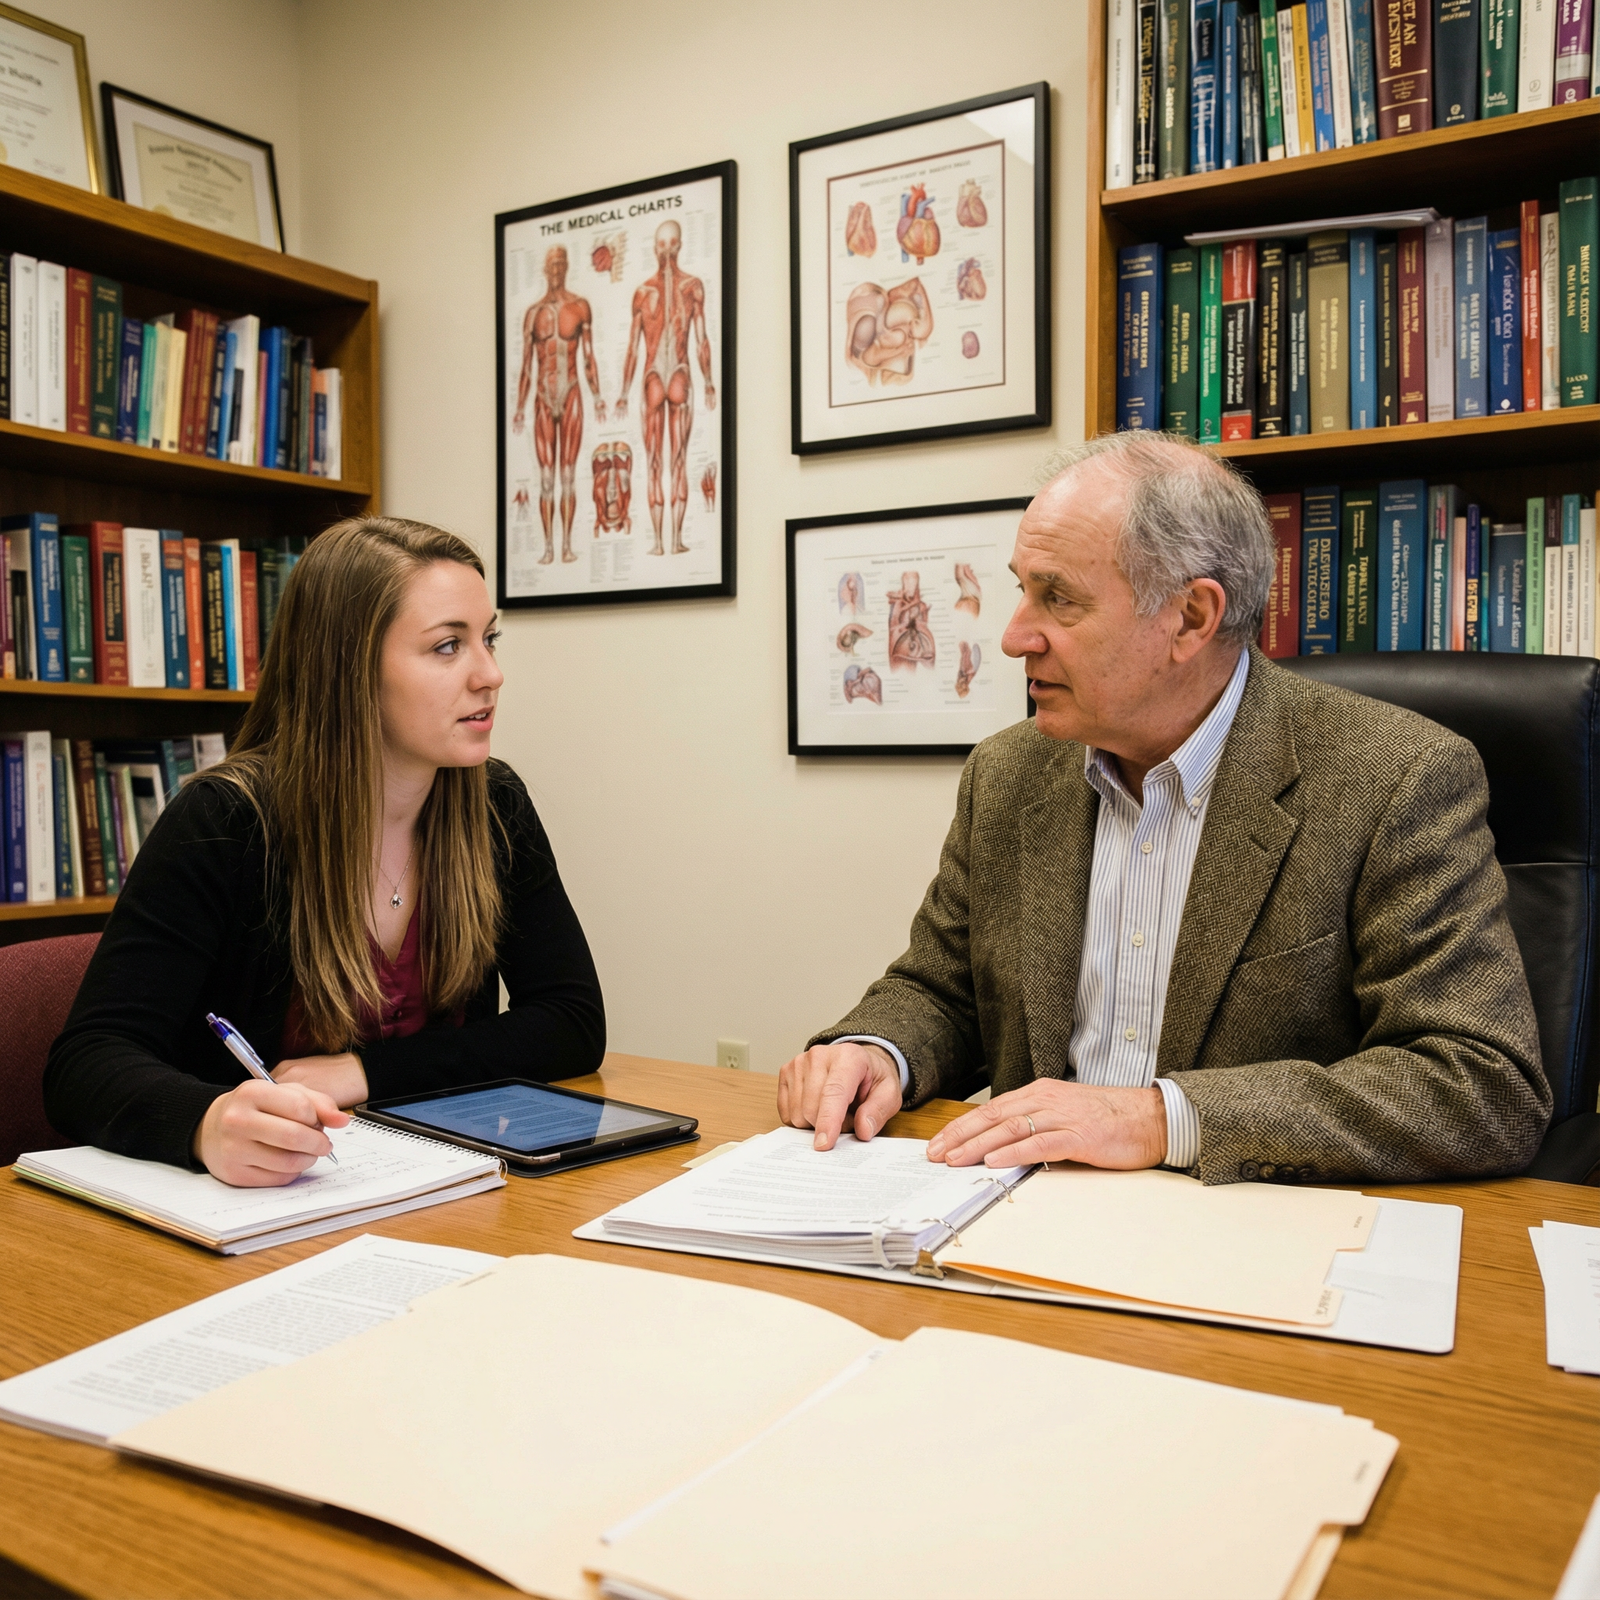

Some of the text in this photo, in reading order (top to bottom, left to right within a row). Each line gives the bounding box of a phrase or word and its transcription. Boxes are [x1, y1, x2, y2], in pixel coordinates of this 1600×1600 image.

[540, 195, 683, 237] THE MEDICAL CHARTS
